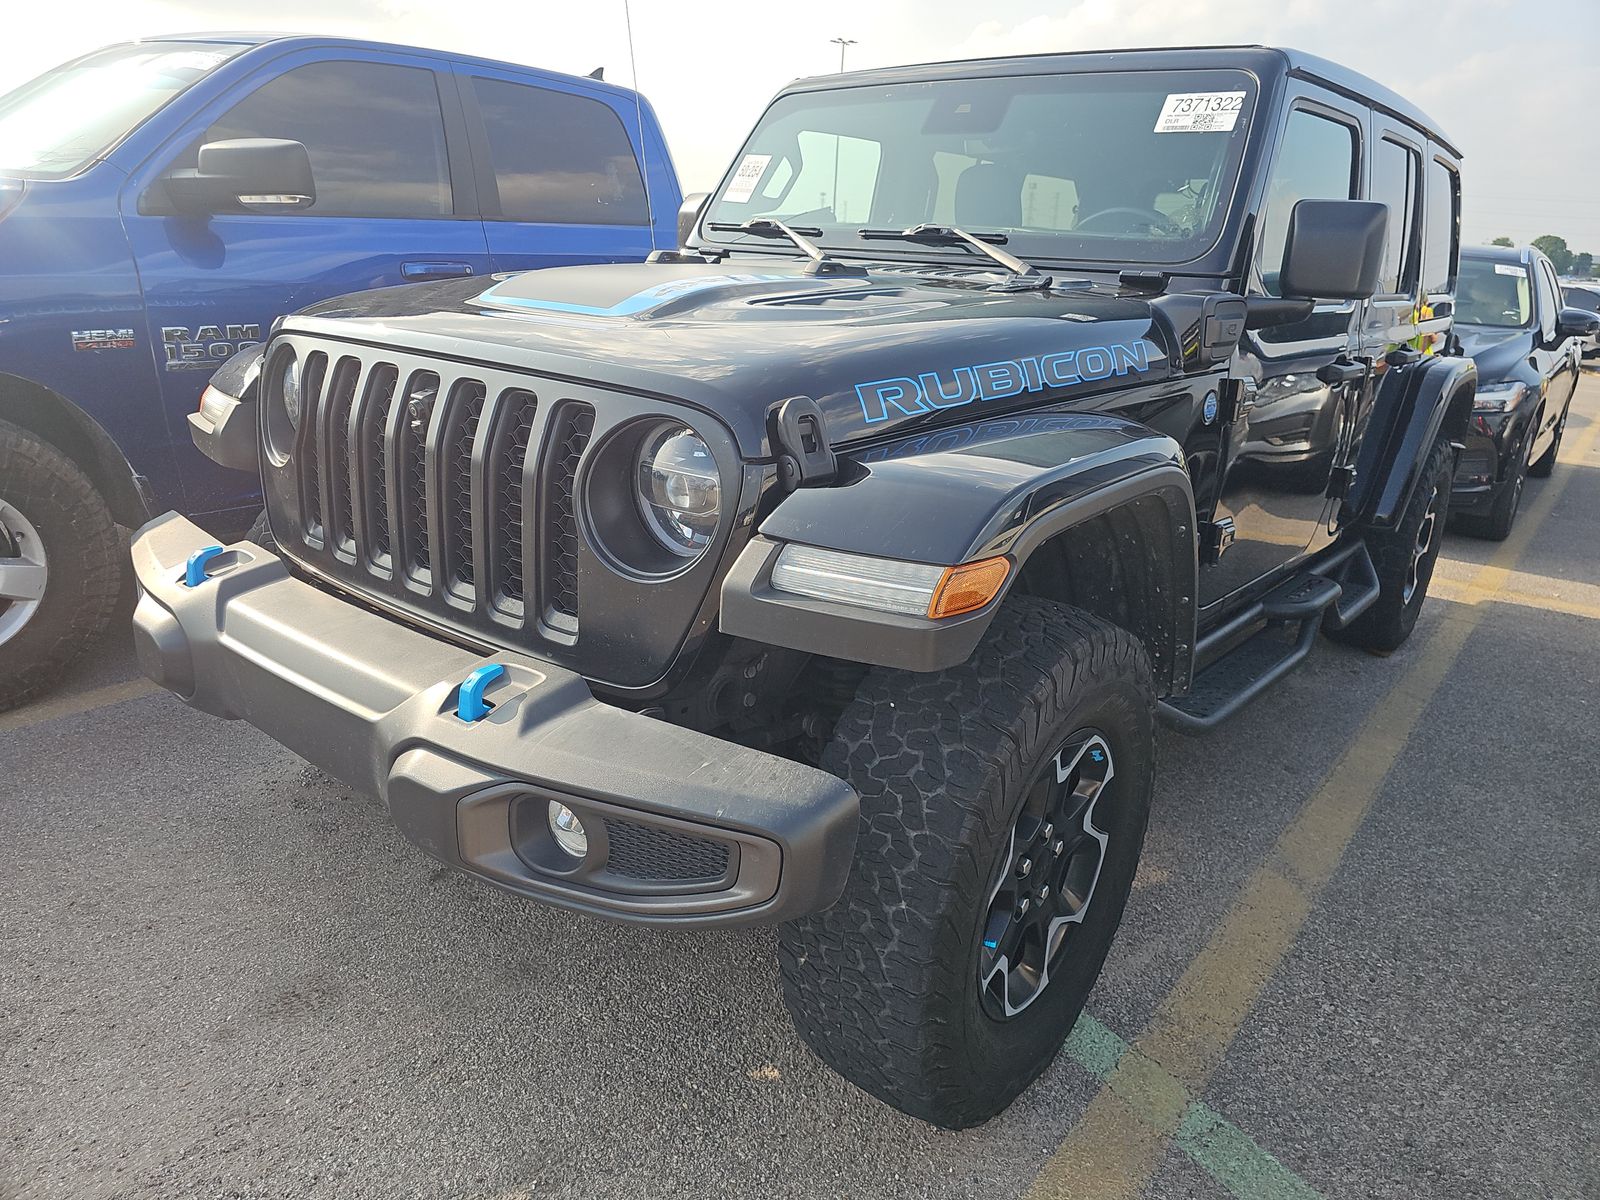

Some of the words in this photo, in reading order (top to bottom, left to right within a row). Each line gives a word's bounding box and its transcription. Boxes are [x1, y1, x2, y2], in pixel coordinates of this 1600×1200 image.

[1173, 96, 1244, 113] 7371322
[71, 329, 134, 341] HEMI
[161, 324, 260, 342] RAM
[854, 341, 1150, 424] RUBICON
